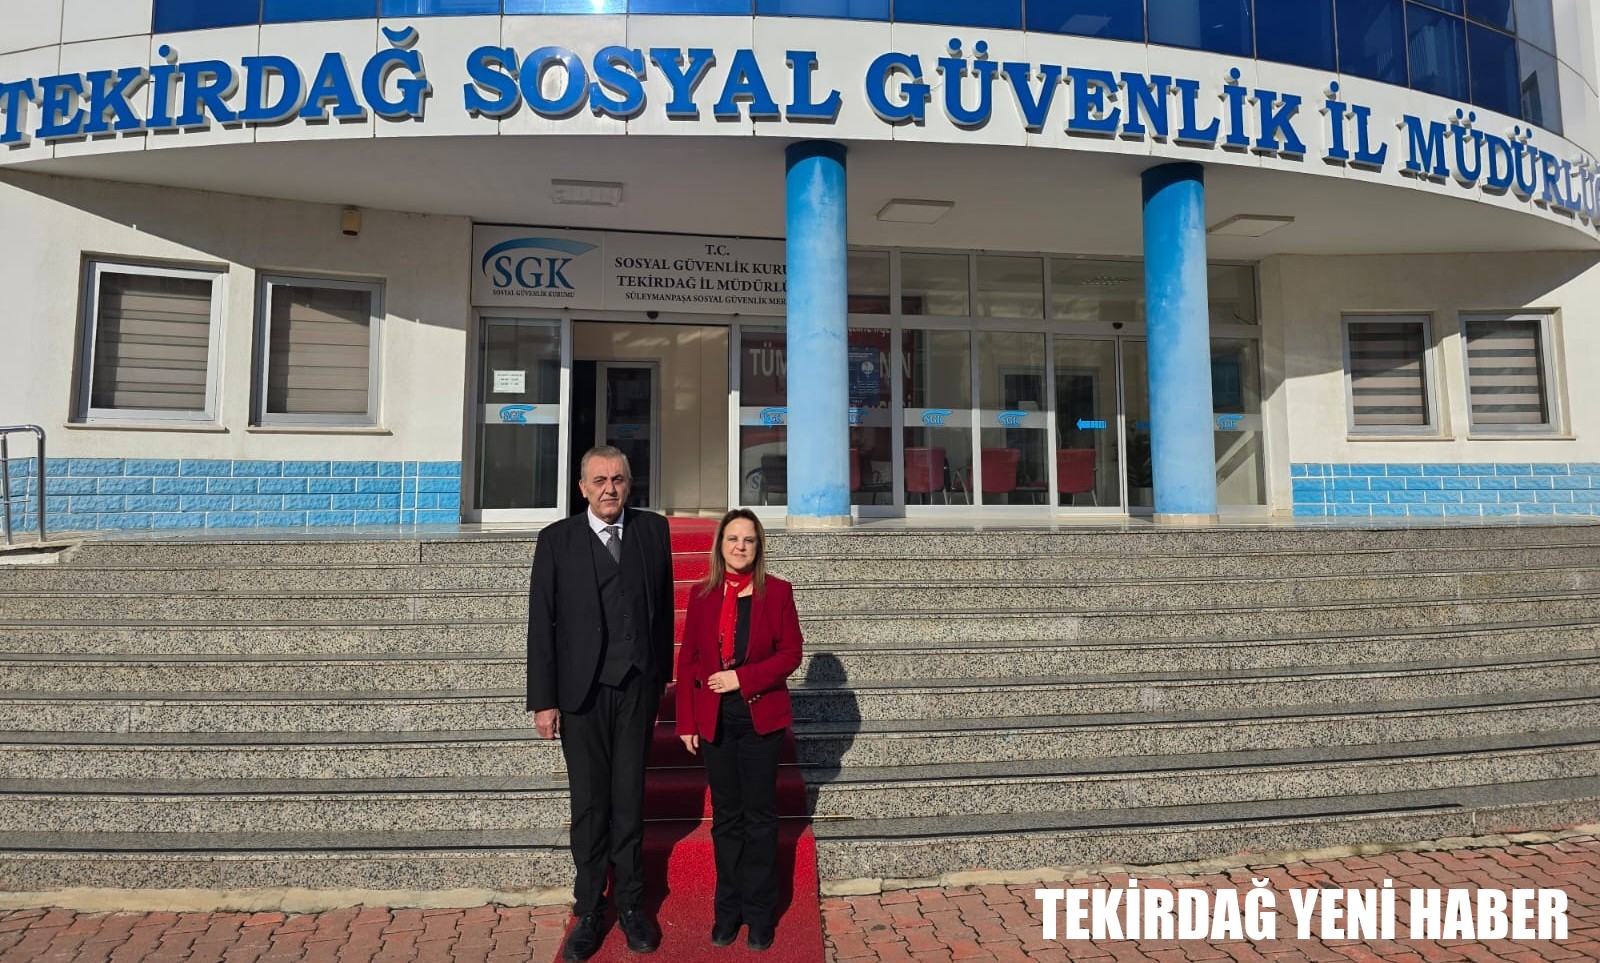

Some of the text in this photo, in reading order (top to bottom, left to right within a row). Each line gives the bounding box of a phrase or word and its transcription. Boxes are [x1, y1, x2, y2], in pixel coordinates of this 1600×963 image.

[0, 26, 430, 144] TEKİRDAĞ
[464, 45, 842, 122] SOSYAL
[866, 38, 1306, 154] GÜVENLİK
[1323, 80, 1388, 166] İL
[705, 244, 730, 256] T.C.
[493, 255, 576, 290] SGK
[615, 257, 670, 270] SOSYAL
[673, 258, 750, 274] GÜVENLİK
[616, 274, 697, 290] TEKİRDAĞ
[700, 276, 714, 290] İL
[625, 291, 692, 304] SÜLEYMANPAŞA
[693, 294, 724, 304] SOSYAL
[725, 295, 767, 305] GÜVENLİK
